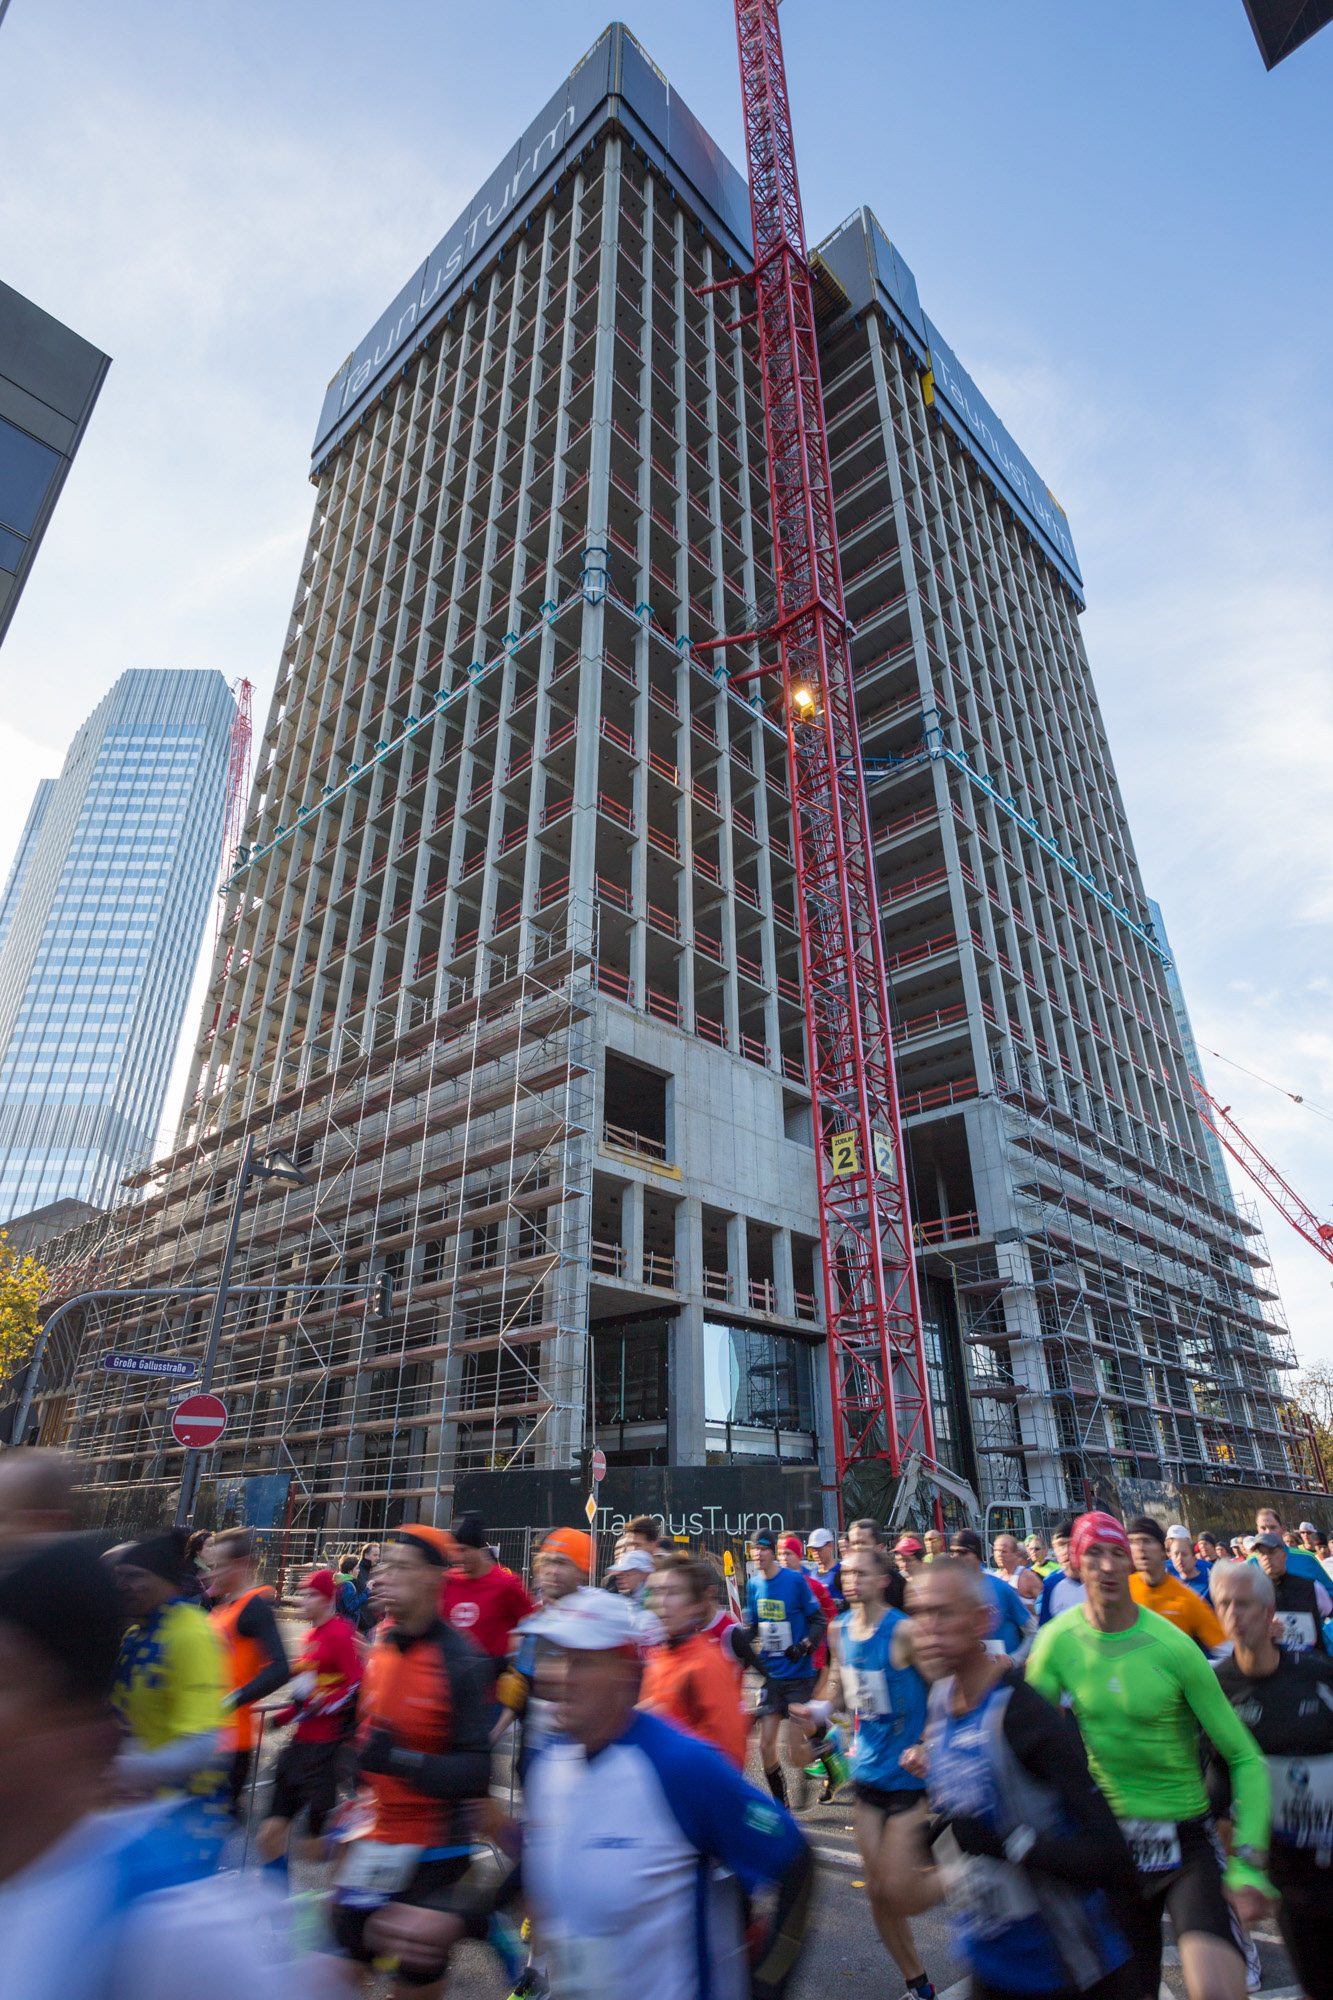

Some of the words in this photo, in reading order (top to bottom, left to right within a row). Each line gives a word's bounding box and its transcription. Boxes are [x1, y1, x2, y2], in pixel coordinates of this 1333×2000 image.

[838, 1147, 853, 1169] 2
[113, 1357, 137, 1369] Große
[138, 1359, 187, 1373] Gallusstraße
[597, 1506, 784, 1536] TanusTurm
